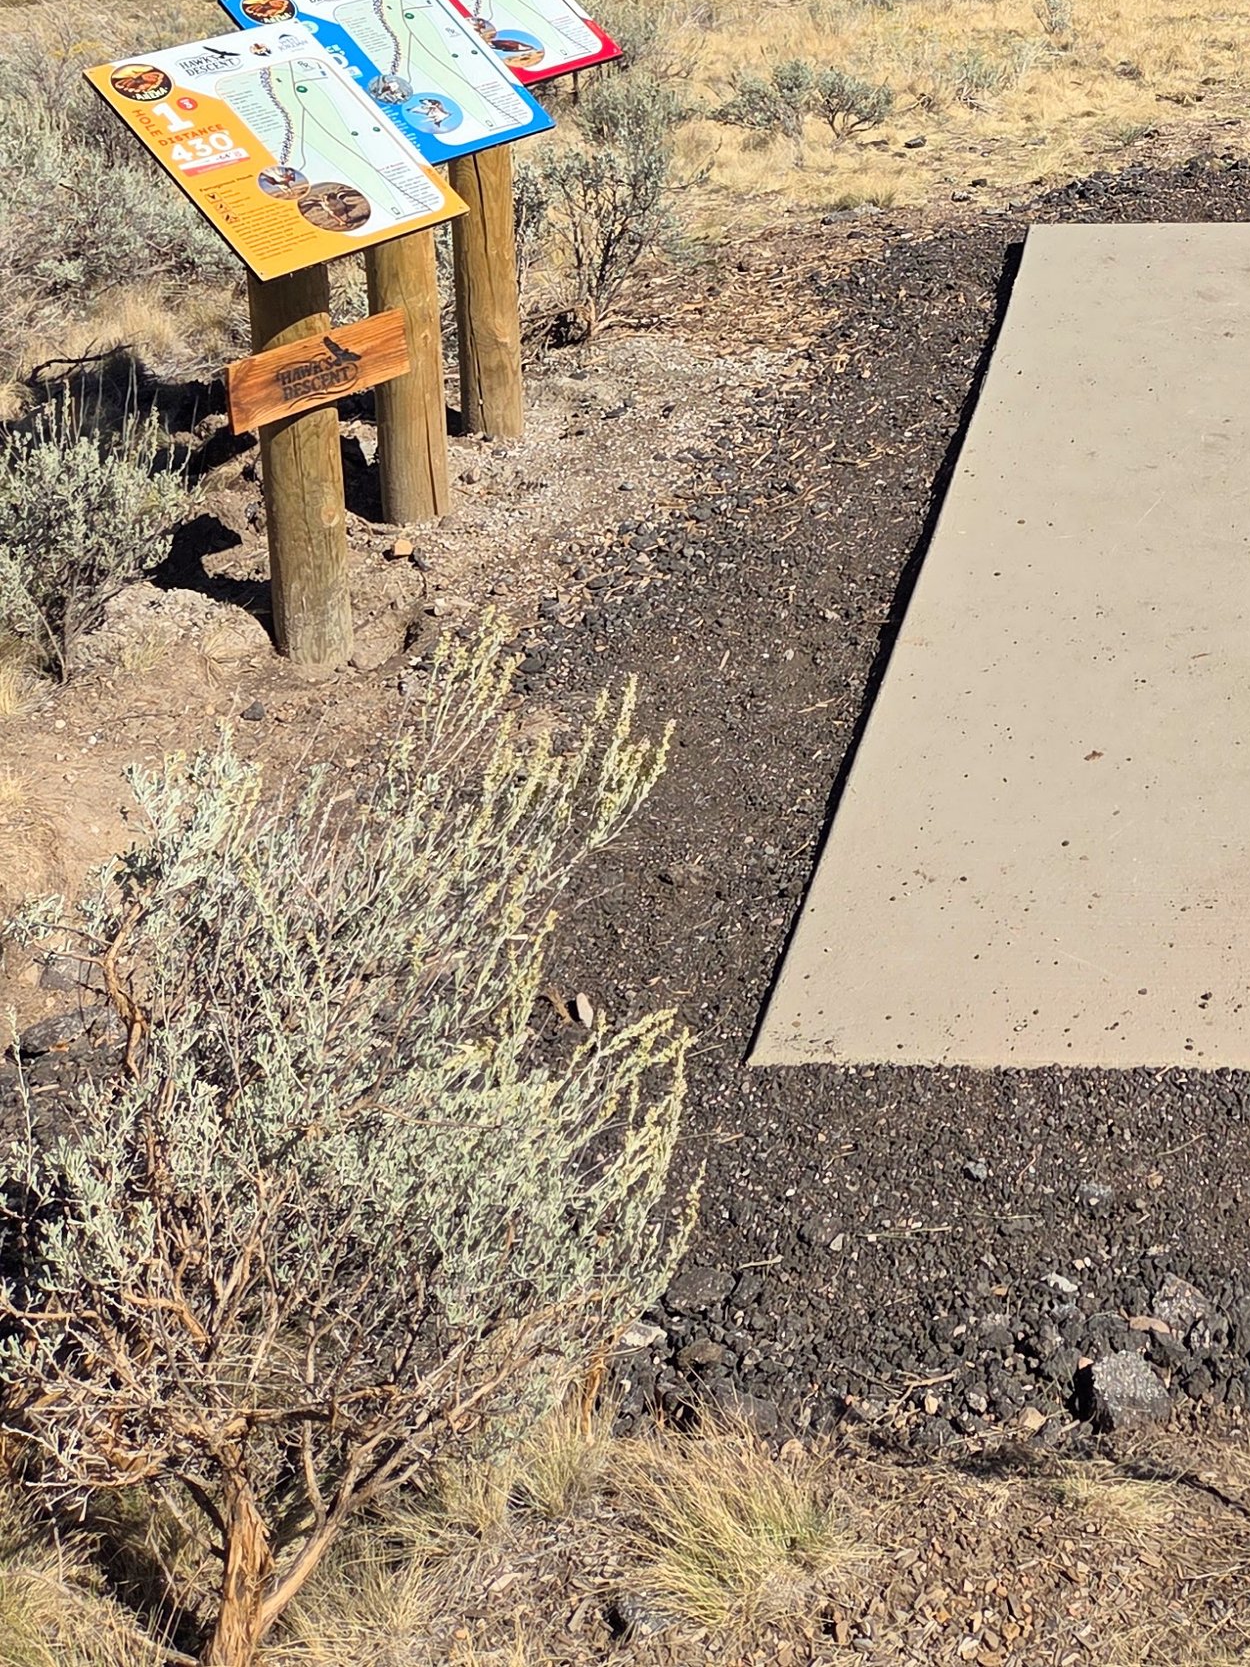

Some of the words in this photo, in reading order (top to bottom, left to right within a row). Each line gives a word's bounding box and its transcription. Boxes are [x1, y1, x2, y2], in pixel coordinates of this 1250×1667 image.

[179, 54, 220, 70] HAWK'S
[185, 58, 235, 77] DESCENT
[132, 109, 163, 137] HOLE
[152, 102, 194, 132] 1
[158, 123, 225, 147] DISTANCE
[282, 366, 350, 401] DESCENT
